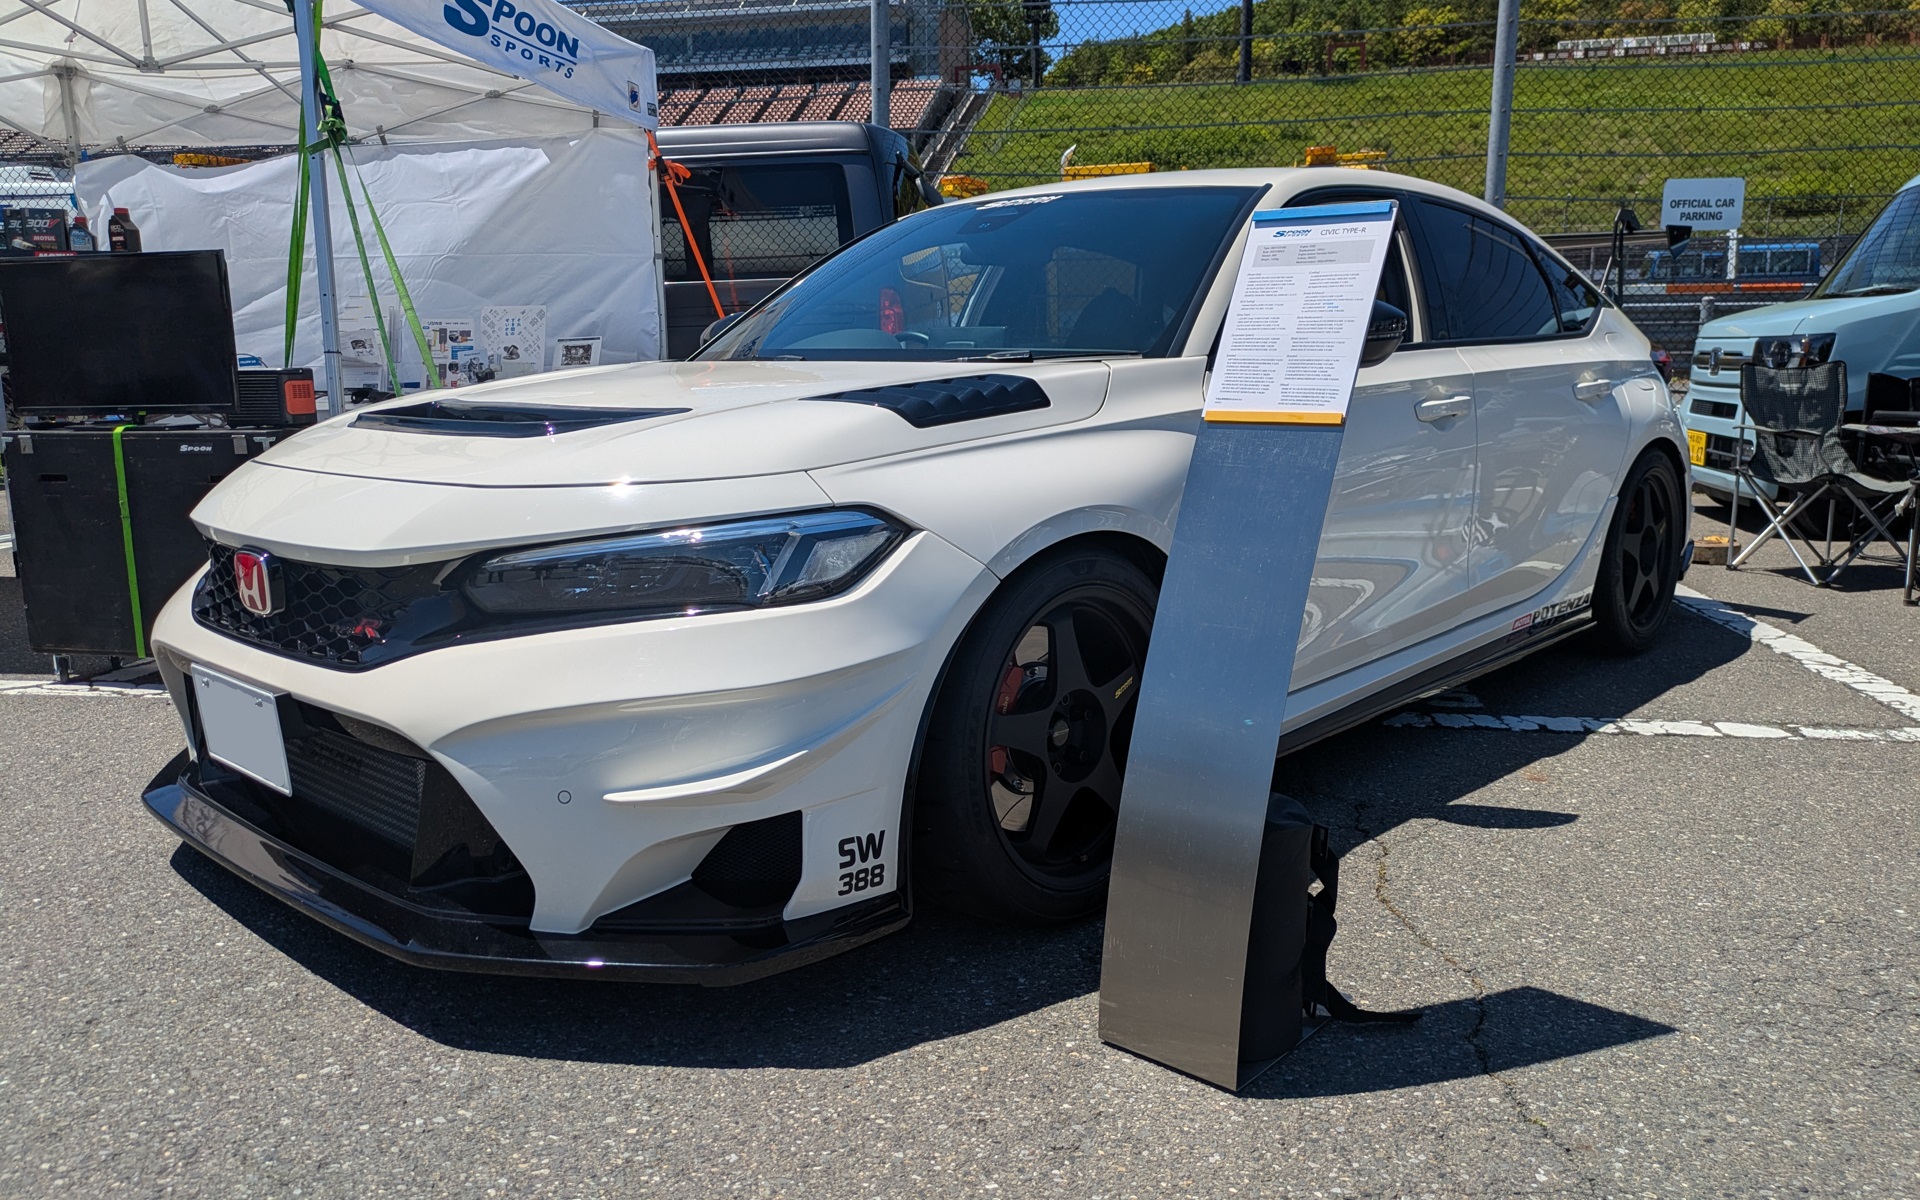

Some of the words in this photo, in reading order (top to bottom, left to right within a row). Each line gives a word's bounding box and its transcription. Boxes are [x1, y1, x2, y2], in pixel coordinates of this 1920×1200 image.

[443, 0, 580, 59] SPOON
[490, 33, 575, 79] SPORTS
[1669, 198, 1712, 209] OFFICIAL
[1715, 198, 1736, 208] CAR
[1679, 211, 1723, 222] PARKING
[26, 218, 61, 229] 300V
[1272, 228, 1312, 238] SPOON
[1320, 228, 1341, 236] CIVIC
[1342, 226, 1367, 235] TYPE-R
[179, 444, 213, 452] SPOON
[1532, 592, 1591, 624] POTENZA
[837, 829, 886, 870] SW
[837, 863, 885, 897] 388
